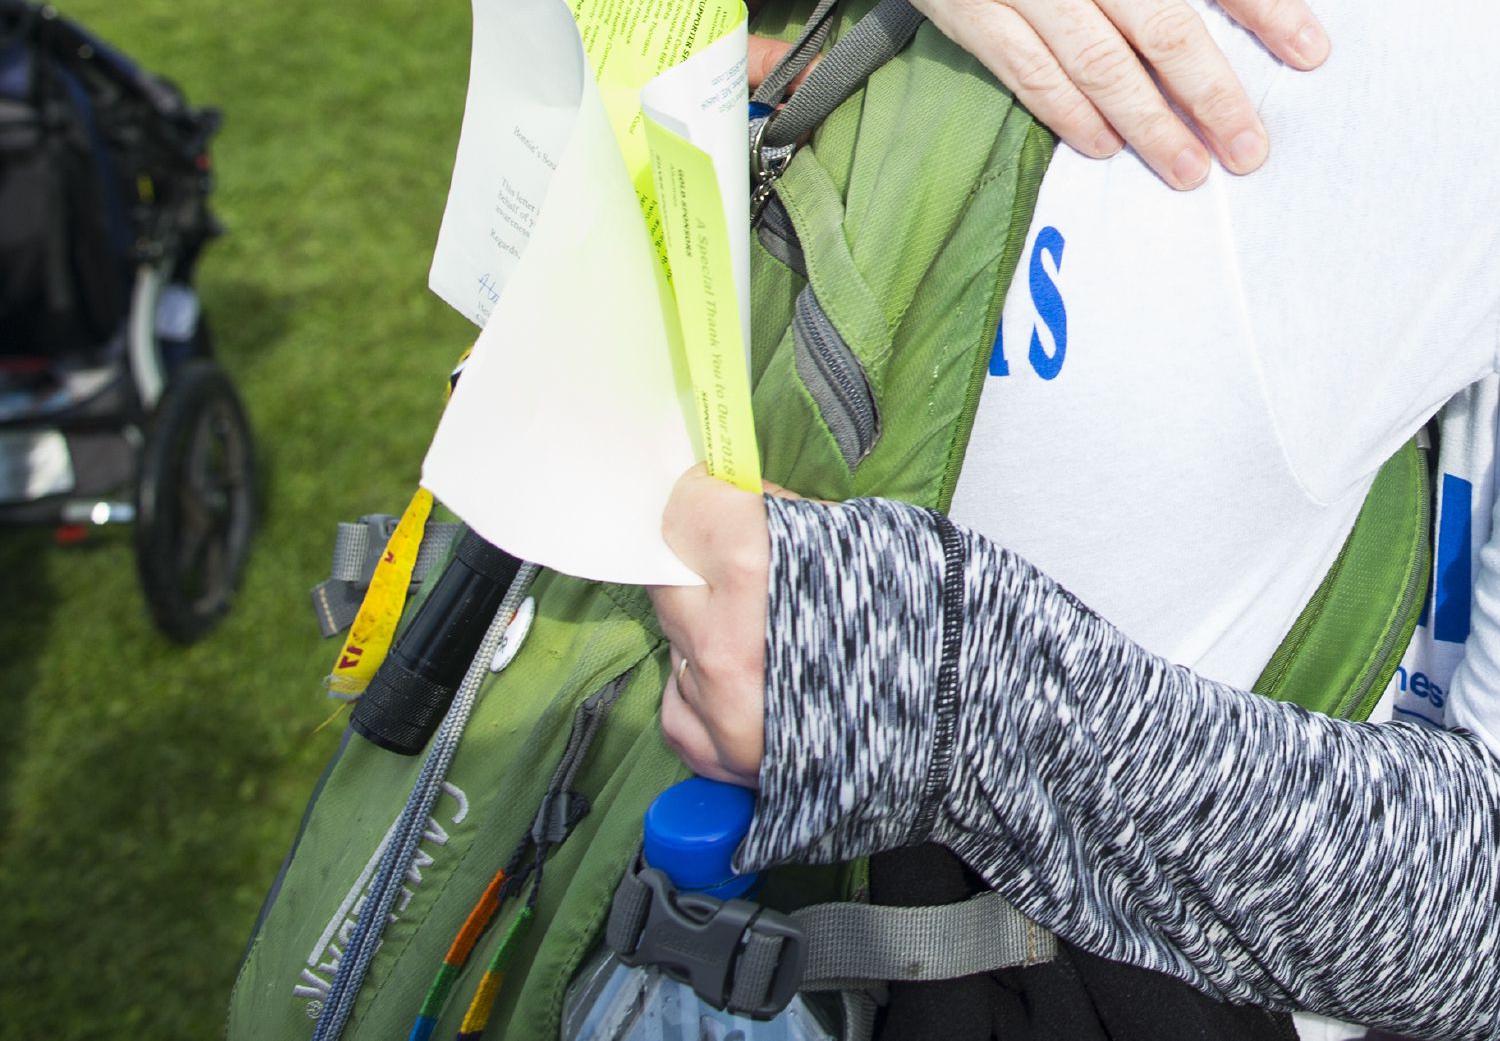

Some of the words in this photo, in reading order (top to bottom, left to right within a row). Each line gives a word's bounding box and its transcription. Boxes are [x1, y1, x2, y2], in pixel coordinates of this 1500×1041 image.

[695, 233, 715, 296] Special
[704, 299, 720, 346] Thank
[710, 352, 724, 378] You
[714, 382, 725, 399] to
[716, 403, 729, 432] Our
[719, 433, 735, 476] 2018
